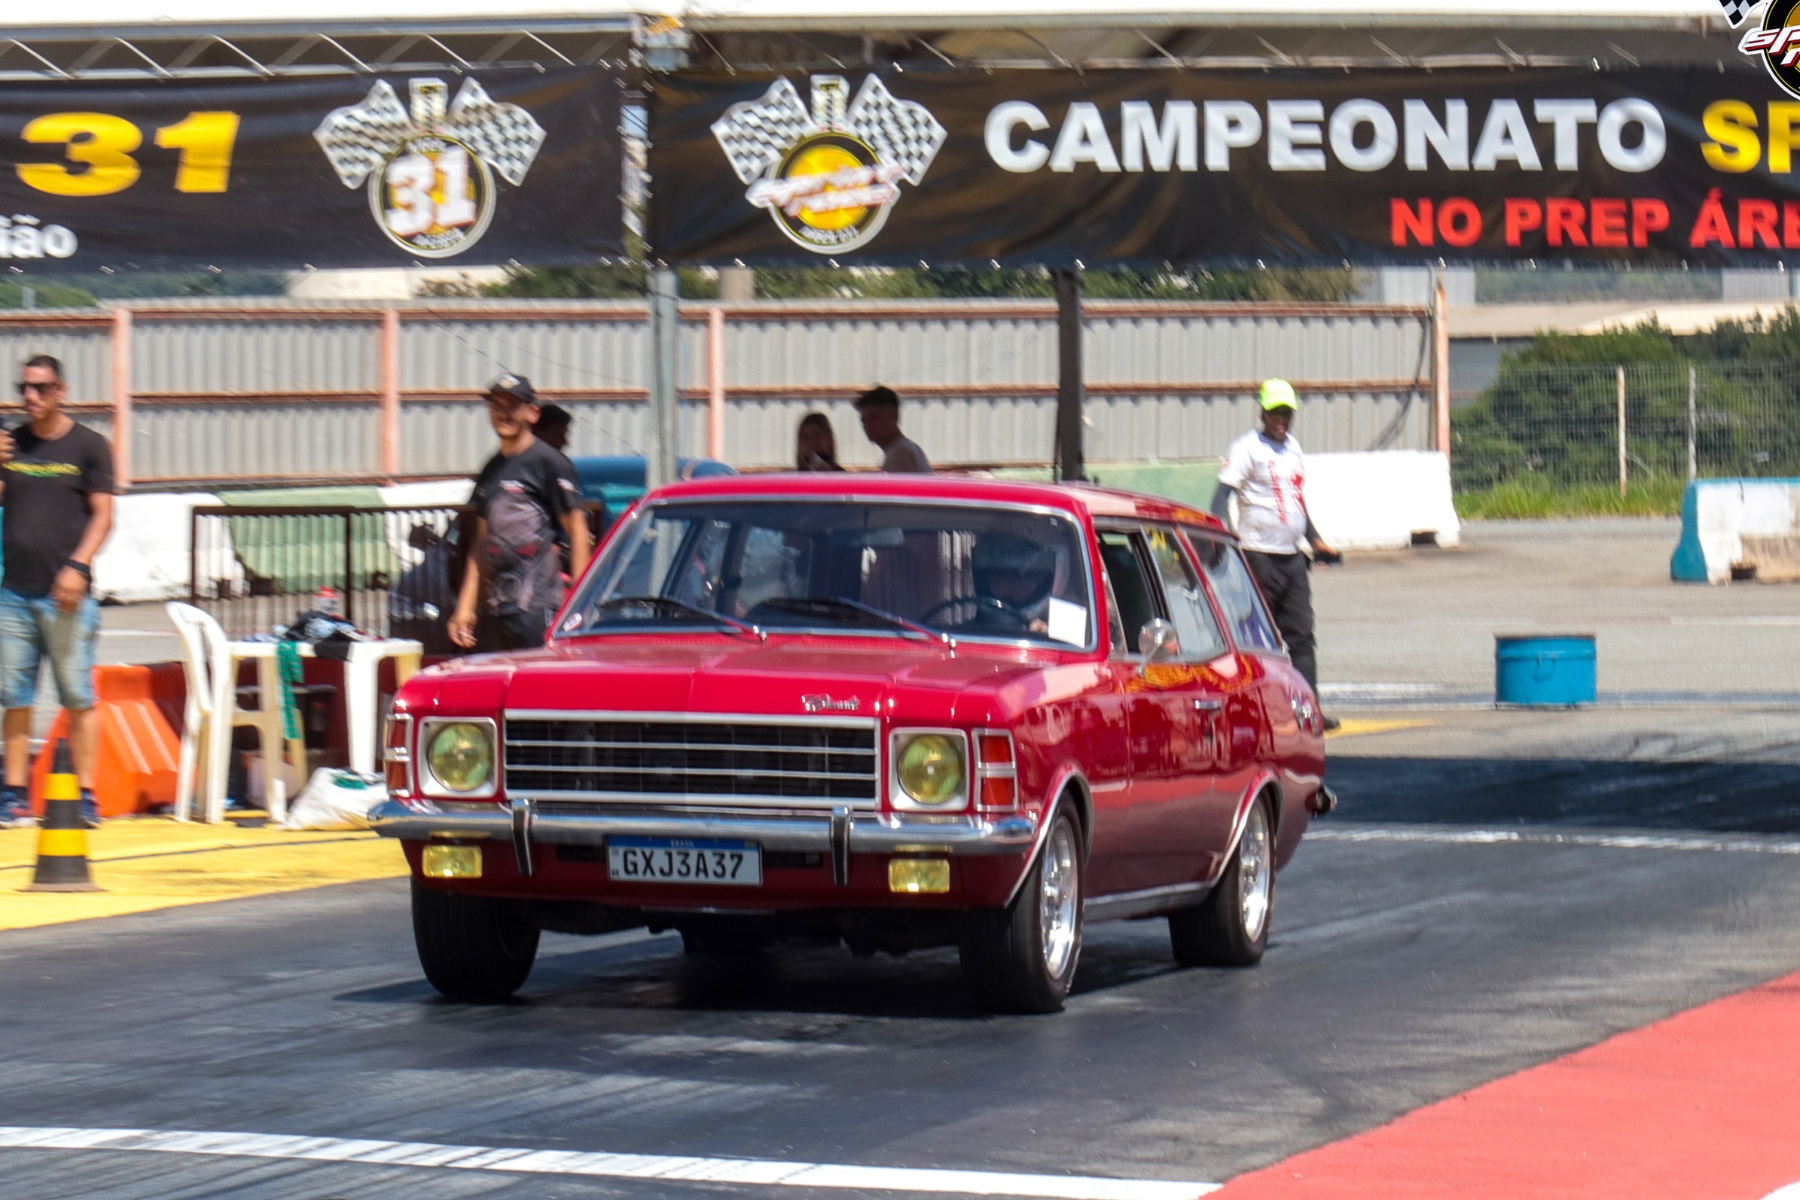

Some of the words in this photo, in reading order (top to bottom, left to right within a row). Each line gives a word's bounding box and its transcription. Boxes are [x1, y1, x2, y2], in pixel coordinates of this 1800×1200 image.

[15, 111, 241, 197] 31
[984, 98, 1667, 173] CAMPEONATO
[385, 146, 477, 238] 31
[1390, 196, 1483, 248] NO
[1504, 197, 1670, 248] PREP
[622, 849, 744, 881] GXJ3A37
